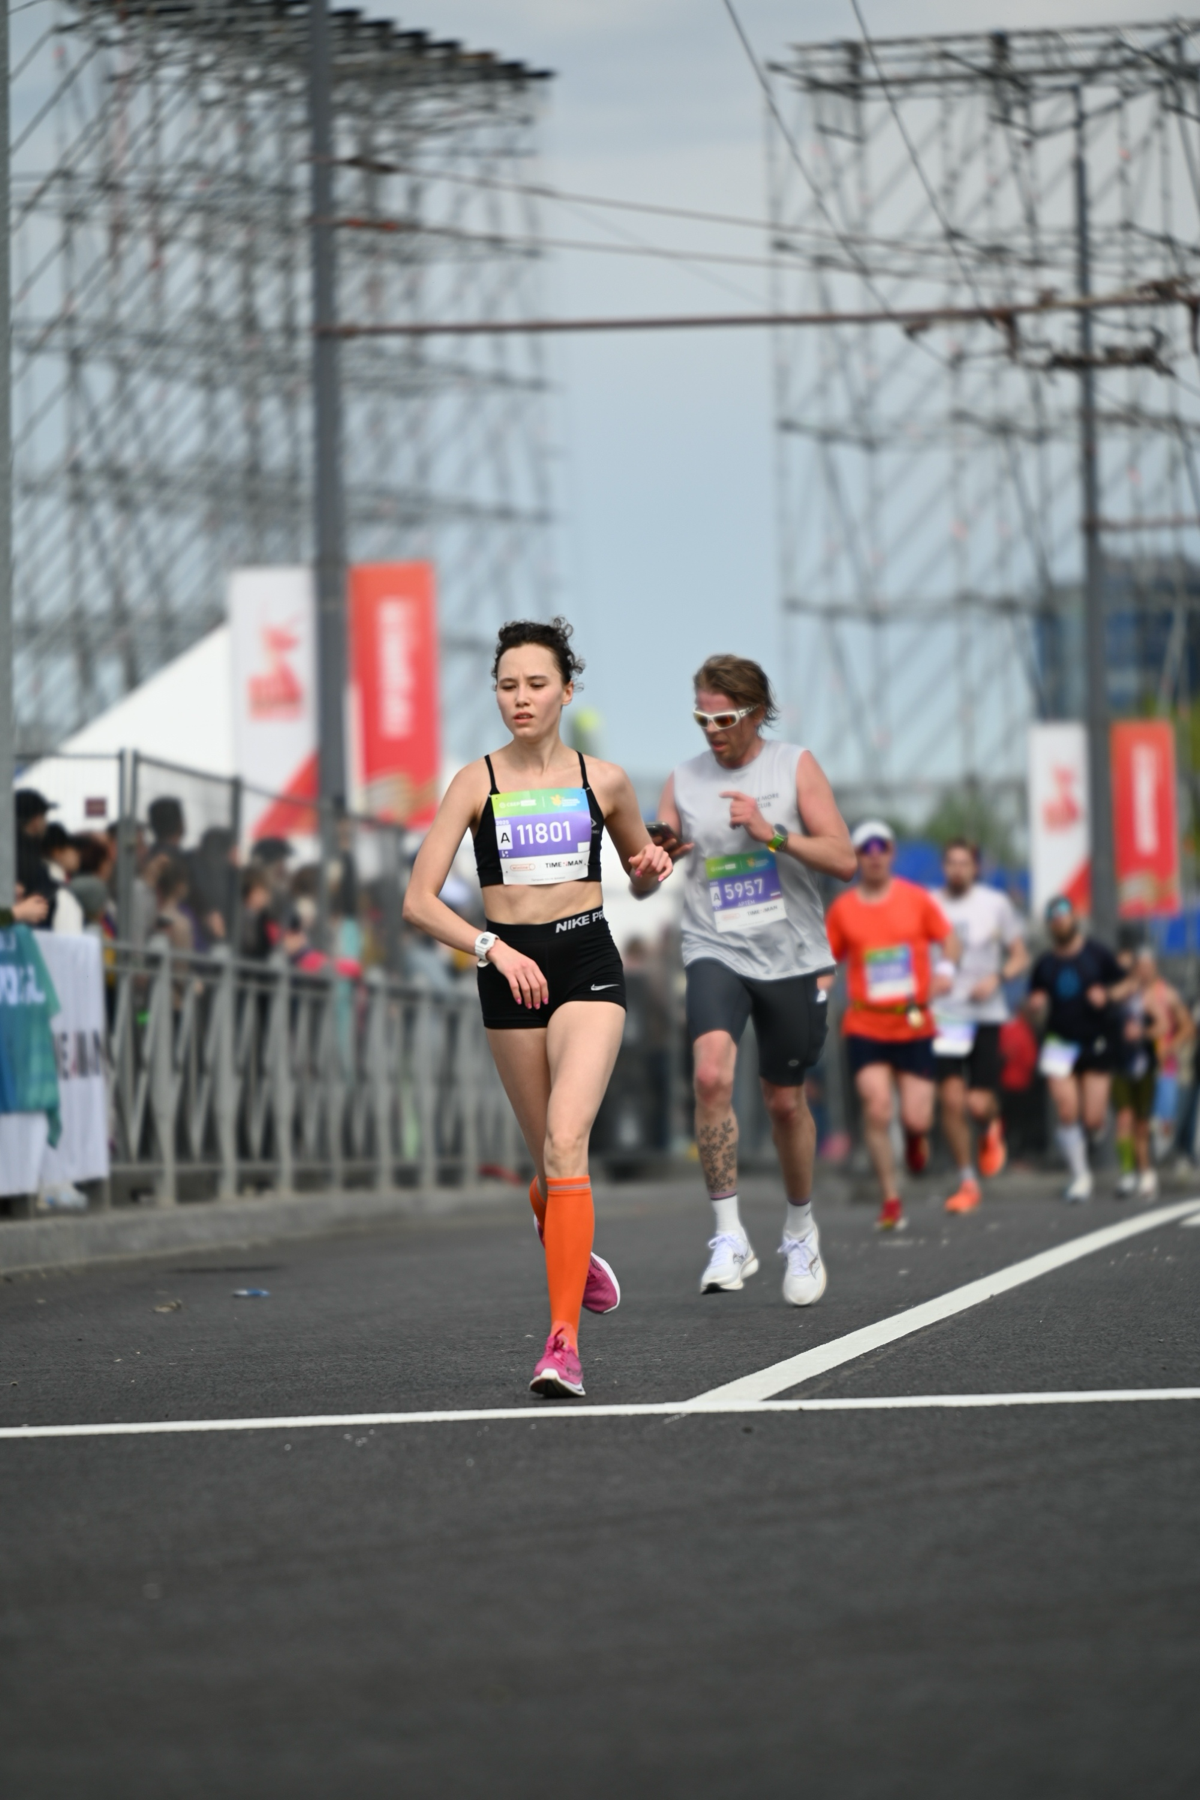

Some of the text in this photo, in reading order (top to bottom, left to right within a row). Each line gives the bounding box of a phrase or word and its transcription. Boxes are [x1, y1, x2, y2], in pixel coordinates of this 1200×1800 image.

[762, 792, 779, 801] MORE
[517, 821, 571, 845] 11801
[724, 878, 763, 900] 5957
[555, 914, 590, 934] NIKE
